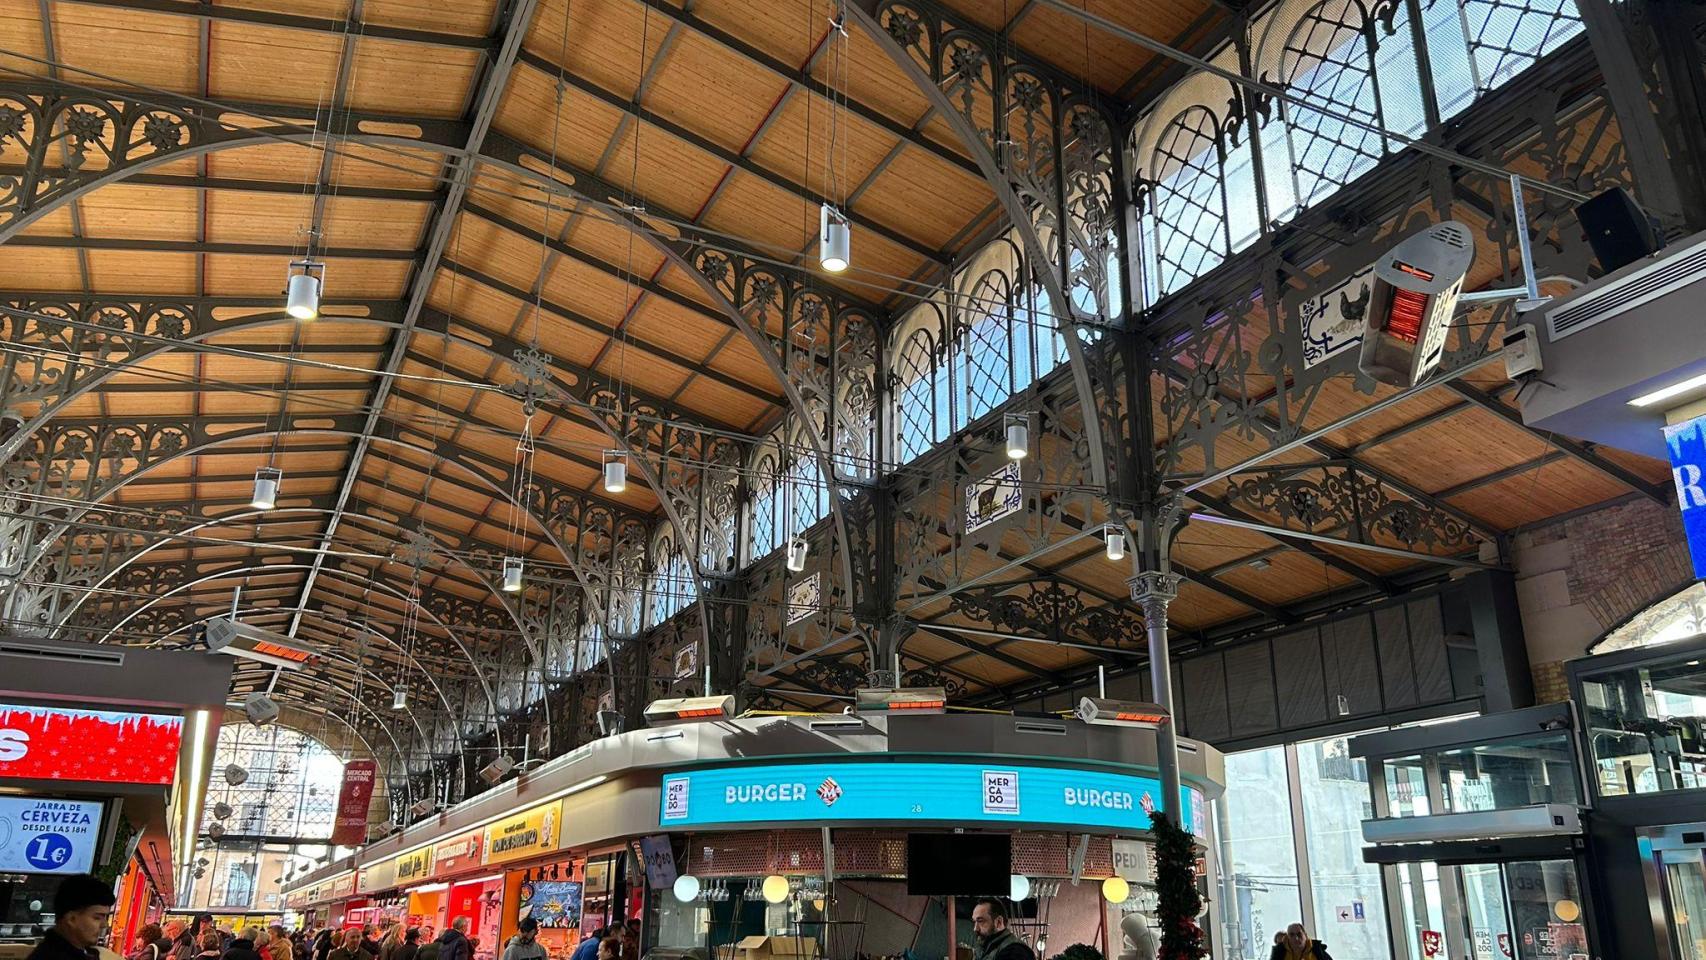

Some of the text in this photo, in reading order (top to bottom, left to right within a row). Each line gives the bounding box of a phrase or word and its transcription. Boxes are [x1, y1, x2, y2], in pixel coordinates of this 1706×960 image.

[346, 769, 372, 777] MERCADO
[988, 777, 1009, 786] MER
[669, 784, 683, 792] MER
[988, 786, 1002, 795] CA
[668, 793, 677, 801] CA
[725, 783, 807, 804] BURGER
[989, 795, 1004, 804] DO
[1064, 787, 1133, 810] BURGER
[35, 802, 66, 811] JARRA
[668, 801, 678, 809] DO
[911, 805, 922, 813] 28
[21, 810, 91, 824] CERVEZA
[22, 824, 50, 832] DESDE
[53, 825, 70, 833] LAS
